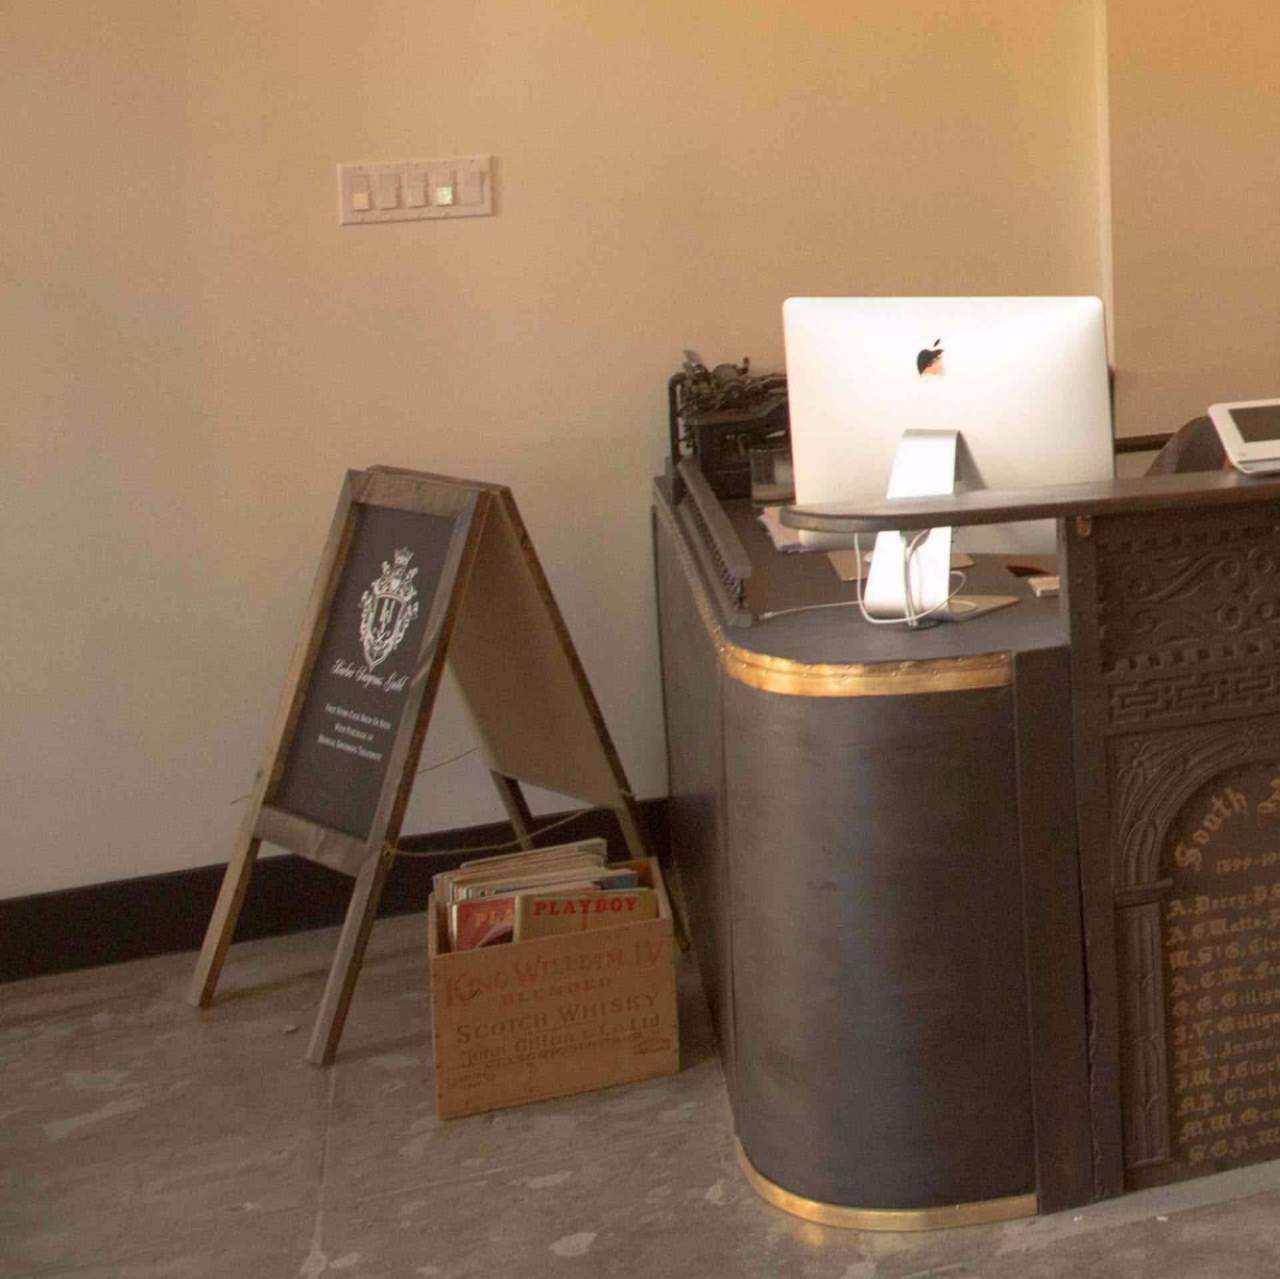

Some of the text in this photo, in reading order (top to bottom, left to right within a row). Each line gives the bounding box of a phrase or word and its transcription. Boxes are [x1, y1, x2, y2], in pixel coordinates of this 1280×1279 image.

[1174, 784, 1248, 872] South
[533, 895, 638, 916] PLAYBOY
[634, 939, 665, 967] IV
[456, 992, 660, 1045] SCOTCH WHISKY
